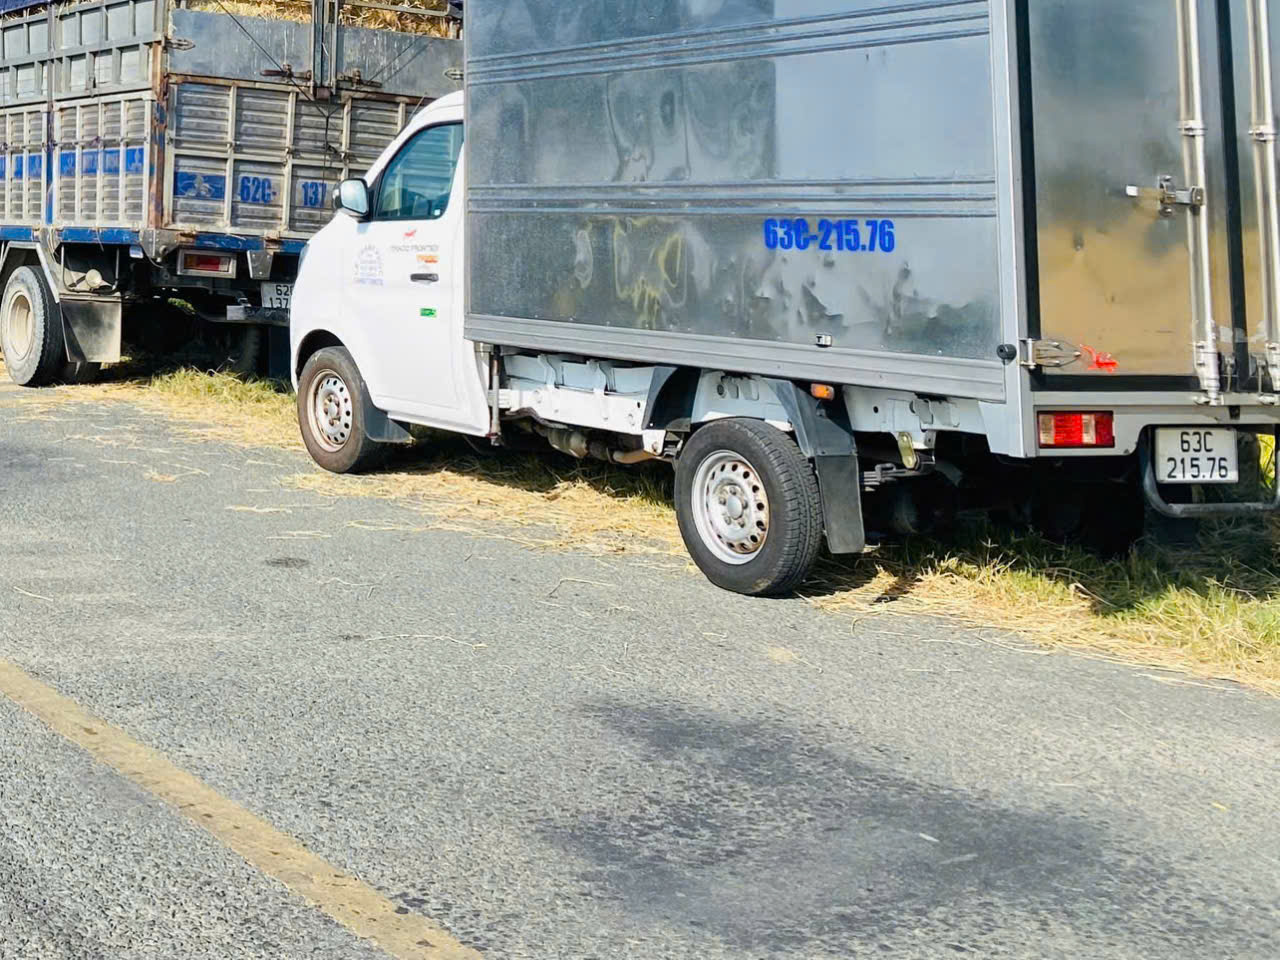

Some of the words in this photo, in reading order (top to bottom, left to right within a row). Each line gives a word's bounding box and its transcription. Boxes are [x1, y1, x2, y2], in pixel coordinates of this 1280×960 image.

[302, 181, 327, 208] 137
[764, 218, 895, 253] 63C-215.76
[1180, 431, 1214, 453] 63C
[1167, 457, 1228, 479] 215.76
